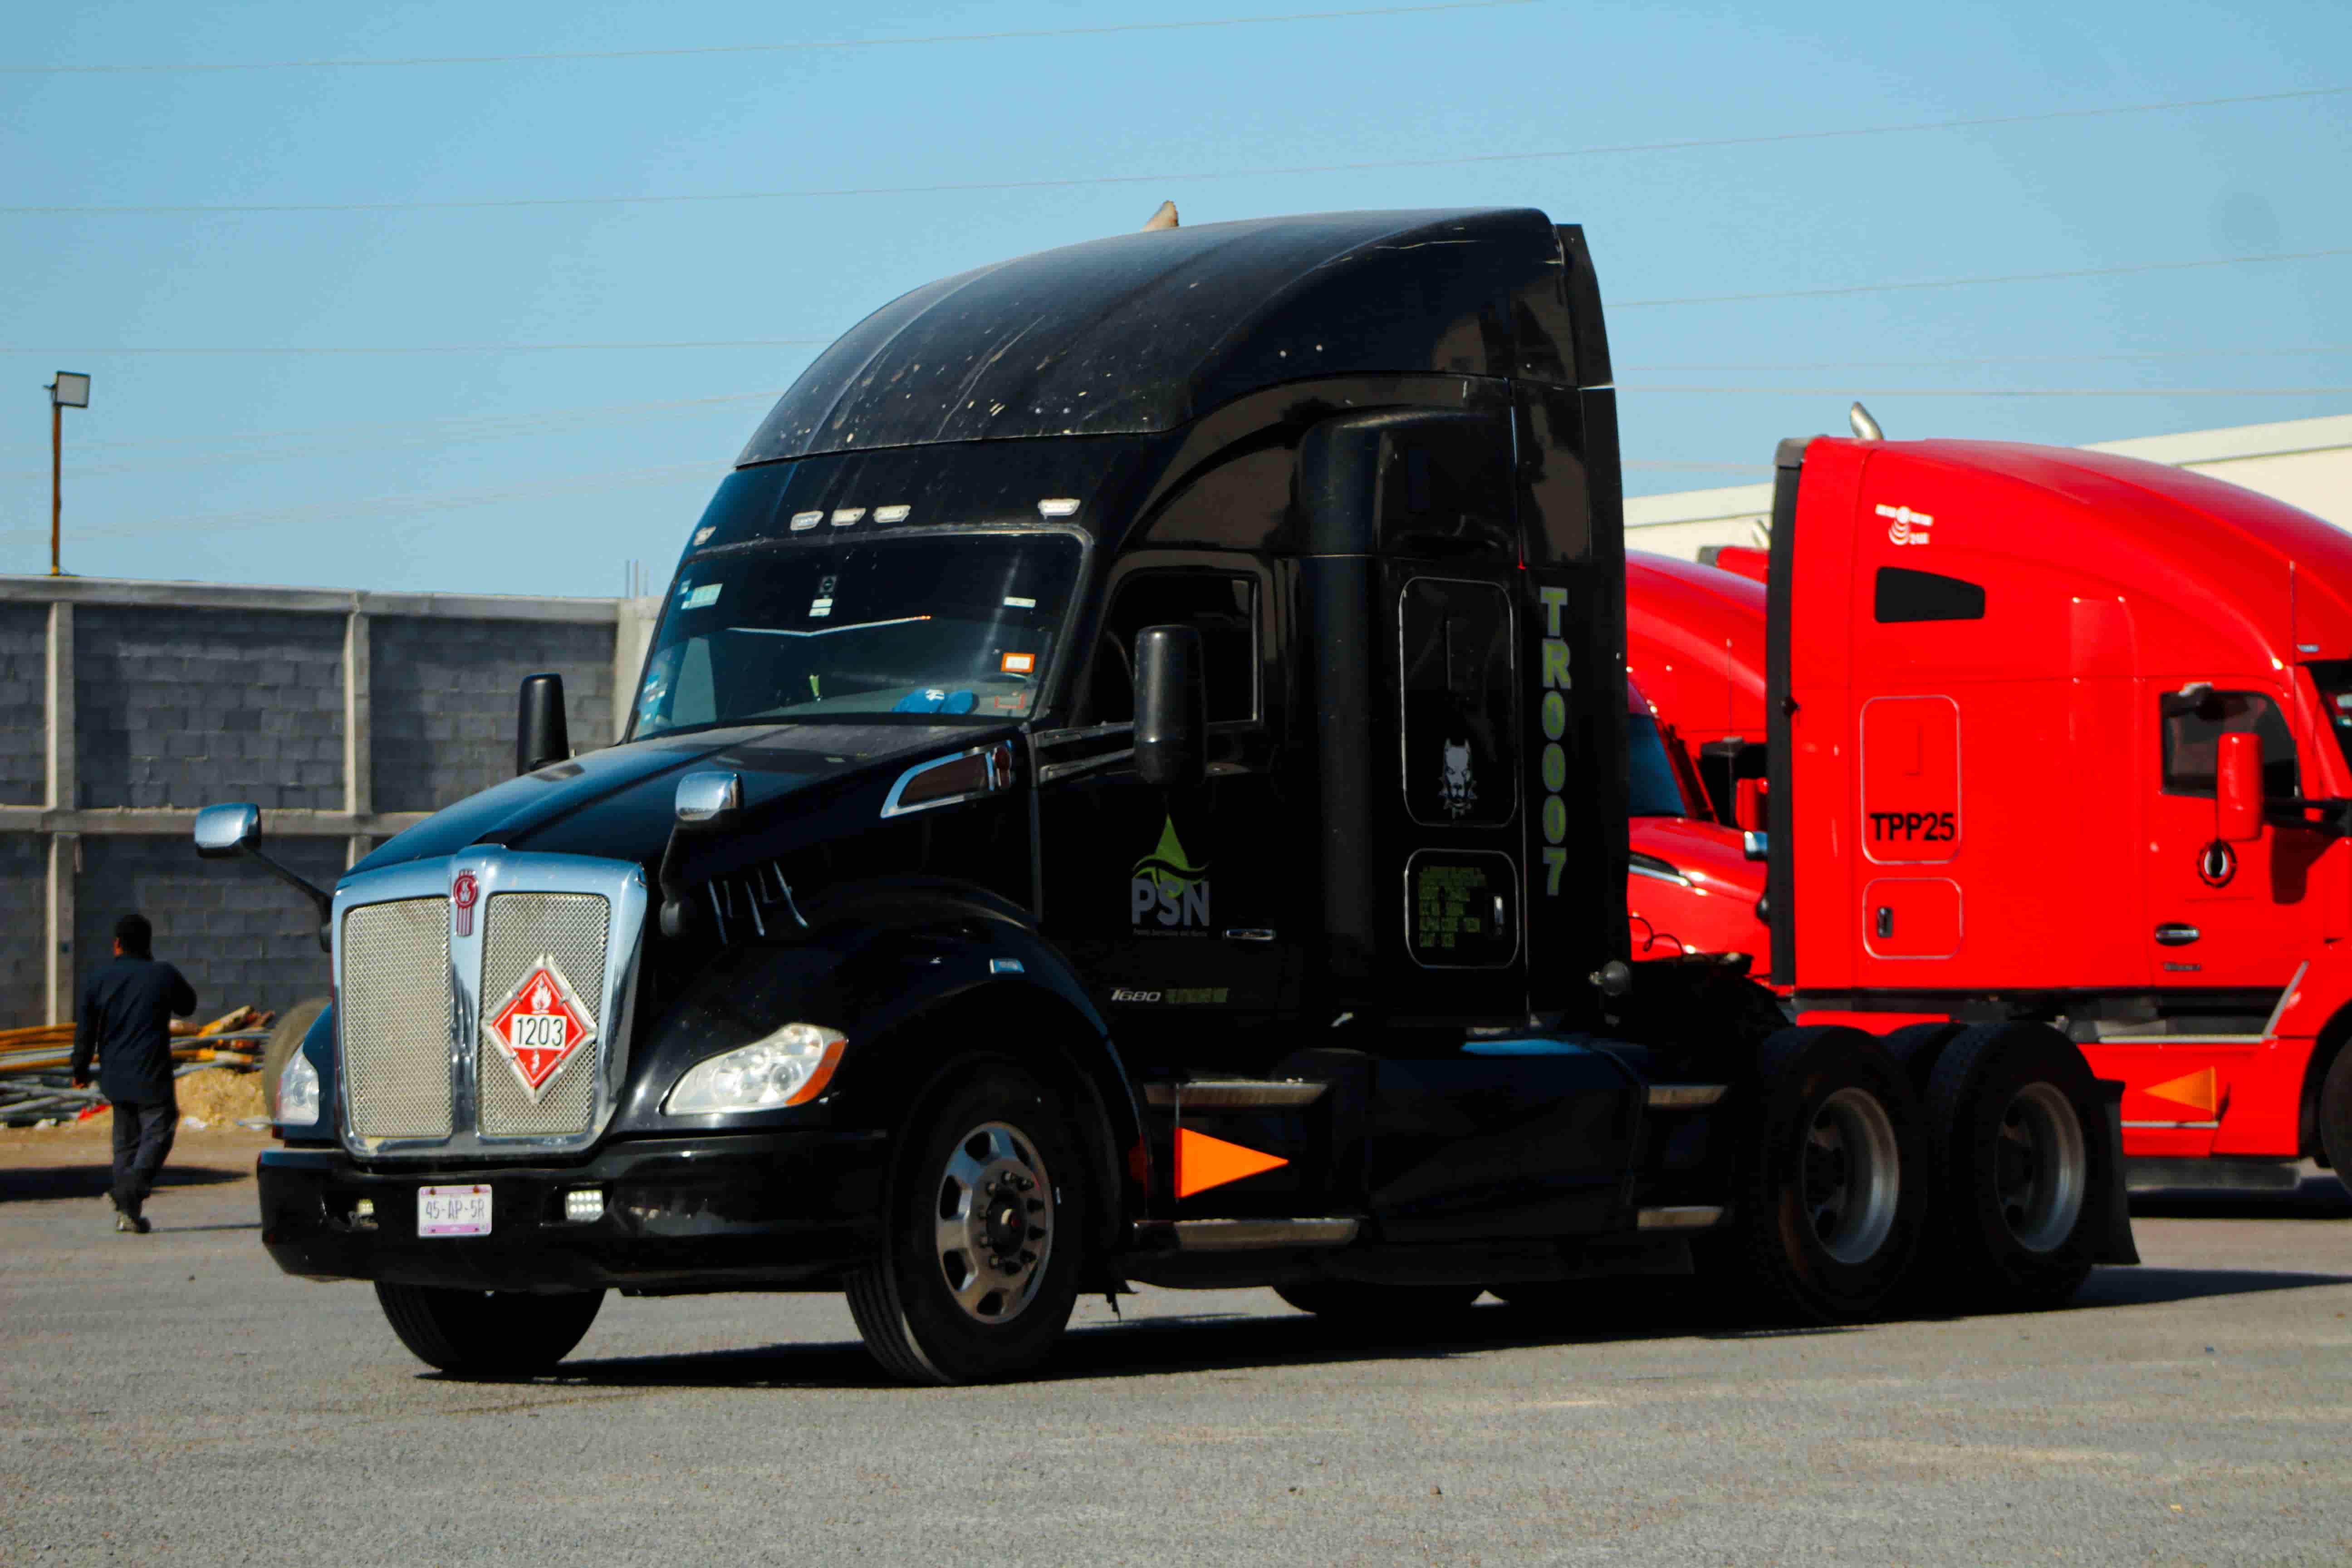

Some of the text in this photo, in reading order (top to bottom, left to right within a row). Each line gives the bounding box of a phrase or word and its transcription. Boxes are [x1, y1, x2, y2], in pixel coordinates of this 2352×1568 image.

[1870, 812, 1955, 842] TPP25
[1132, 877, 1210, 926] PSN
[517, 1017, 563, 1047] 1203
